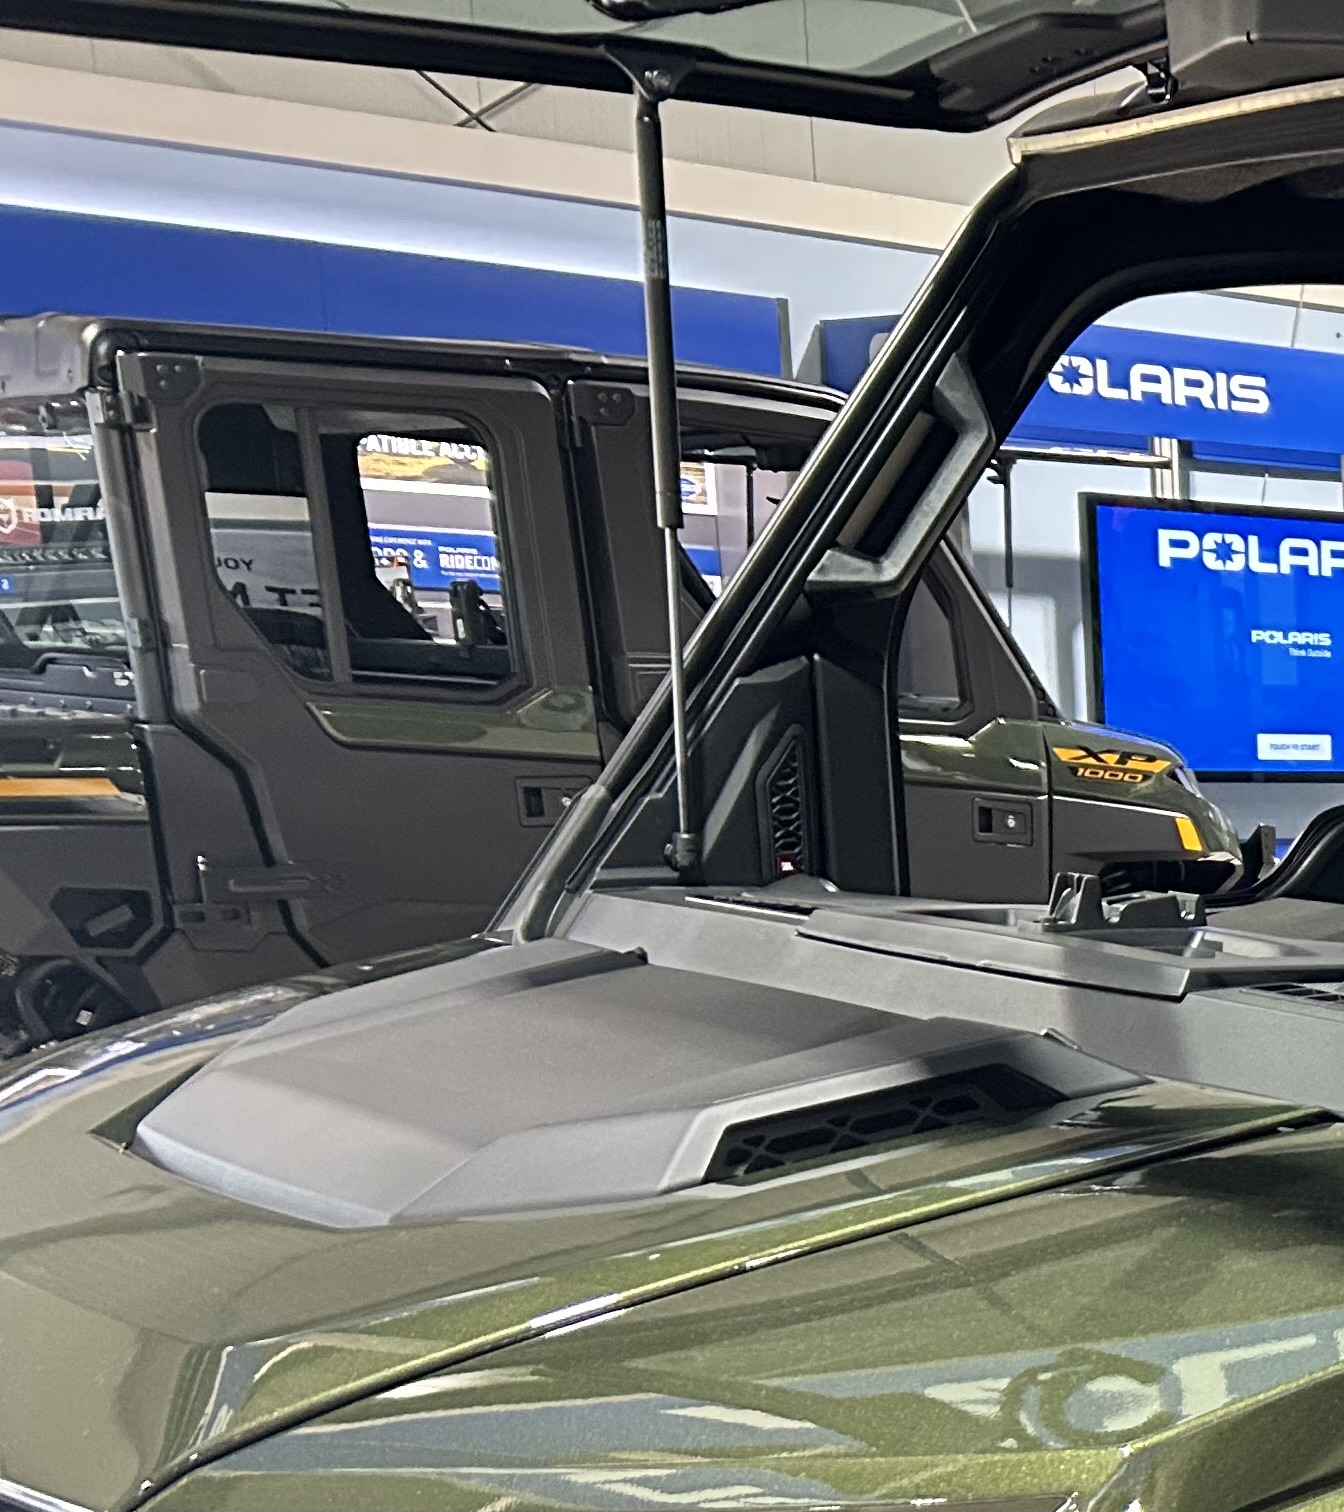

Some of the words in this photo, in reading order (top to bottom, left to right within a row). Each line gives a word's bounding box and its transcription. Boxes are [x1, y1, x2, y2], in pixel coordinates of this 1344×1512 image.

[1048, 355, 1270, 414] OLARIS
[1251, 629, 1331, 646] POLARIS
[1067, 746, 1158, 766] XP
[1076, 767, 1144, 783] 1000
